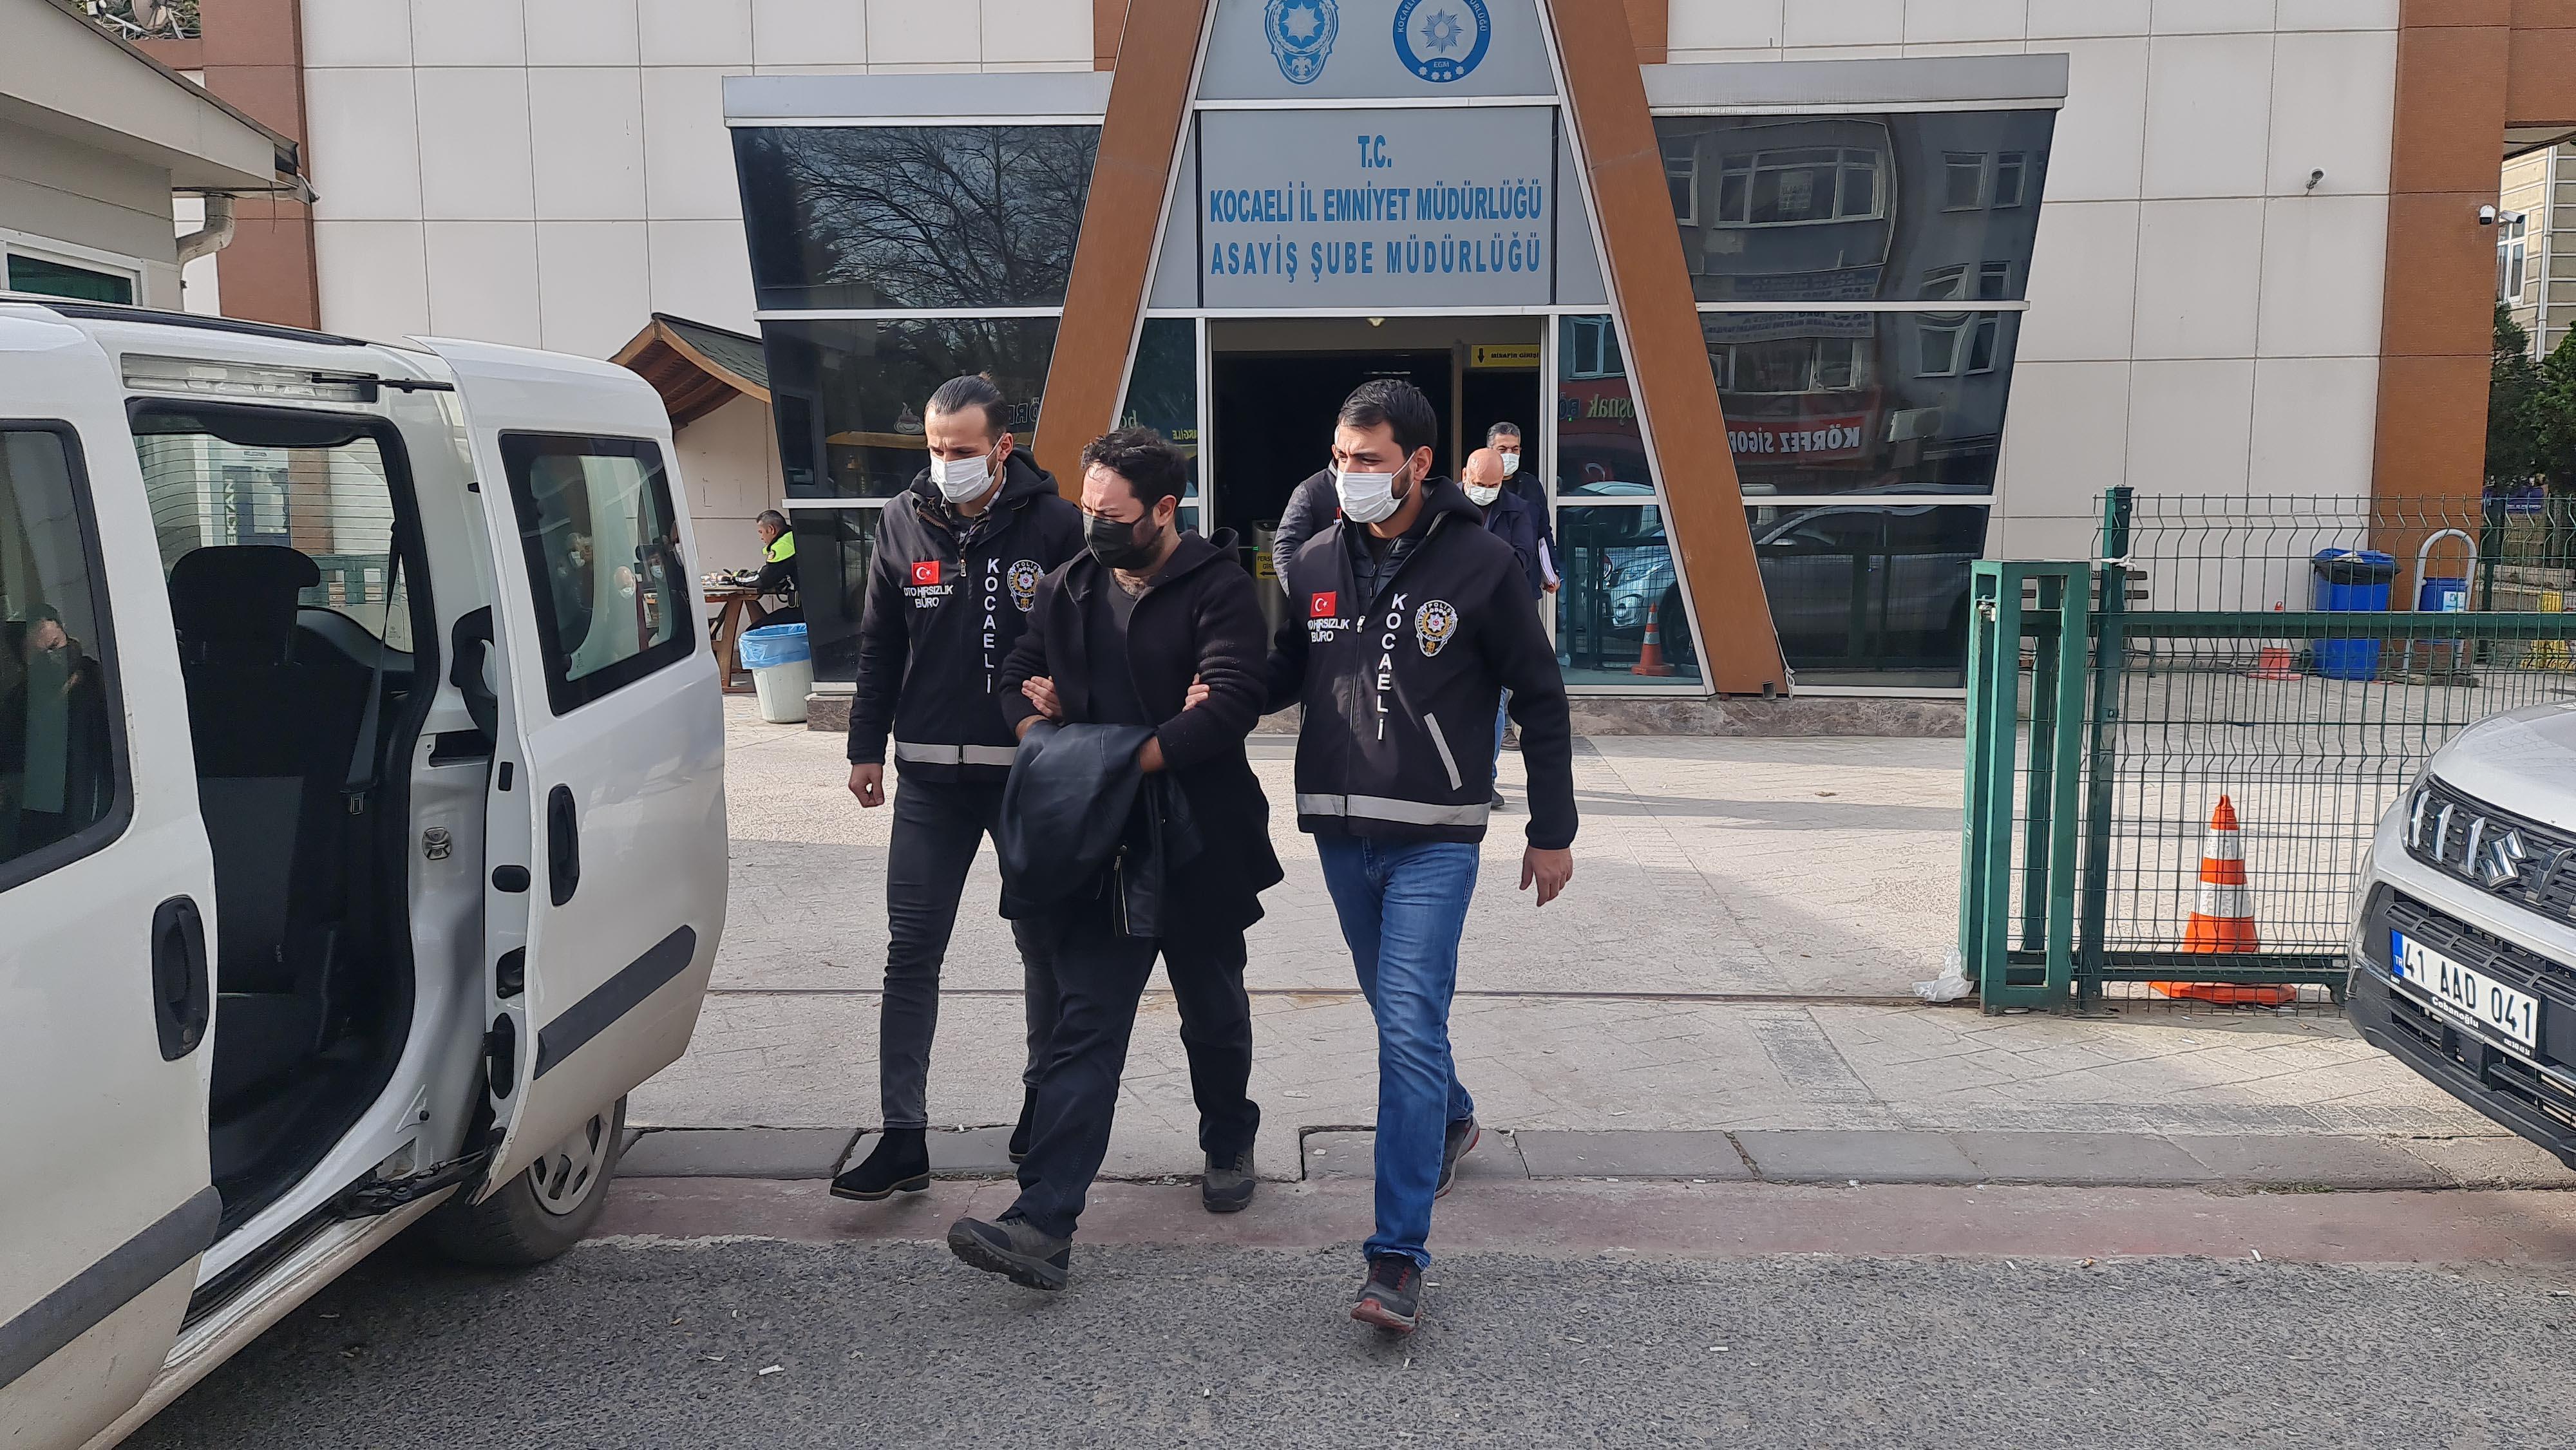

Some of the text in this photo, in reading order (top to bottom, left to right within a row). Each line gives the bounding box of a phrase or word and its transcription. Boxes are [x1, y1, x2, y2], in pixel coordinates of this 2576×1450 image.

[1358, 135, 1392, 169] T.C.
[1210, 178, 1542, 223] KOCAELİ İL EMNİYET MÜDÜRLÜĞÜ
[1211, 231, 1540, 284] ASAYİŞ ŞUBE MÜDÜRLÜĞÜ
[2394, 955, 2403, 968] TR
[2405, 943, 2531, 1040] 41 AAD 041
